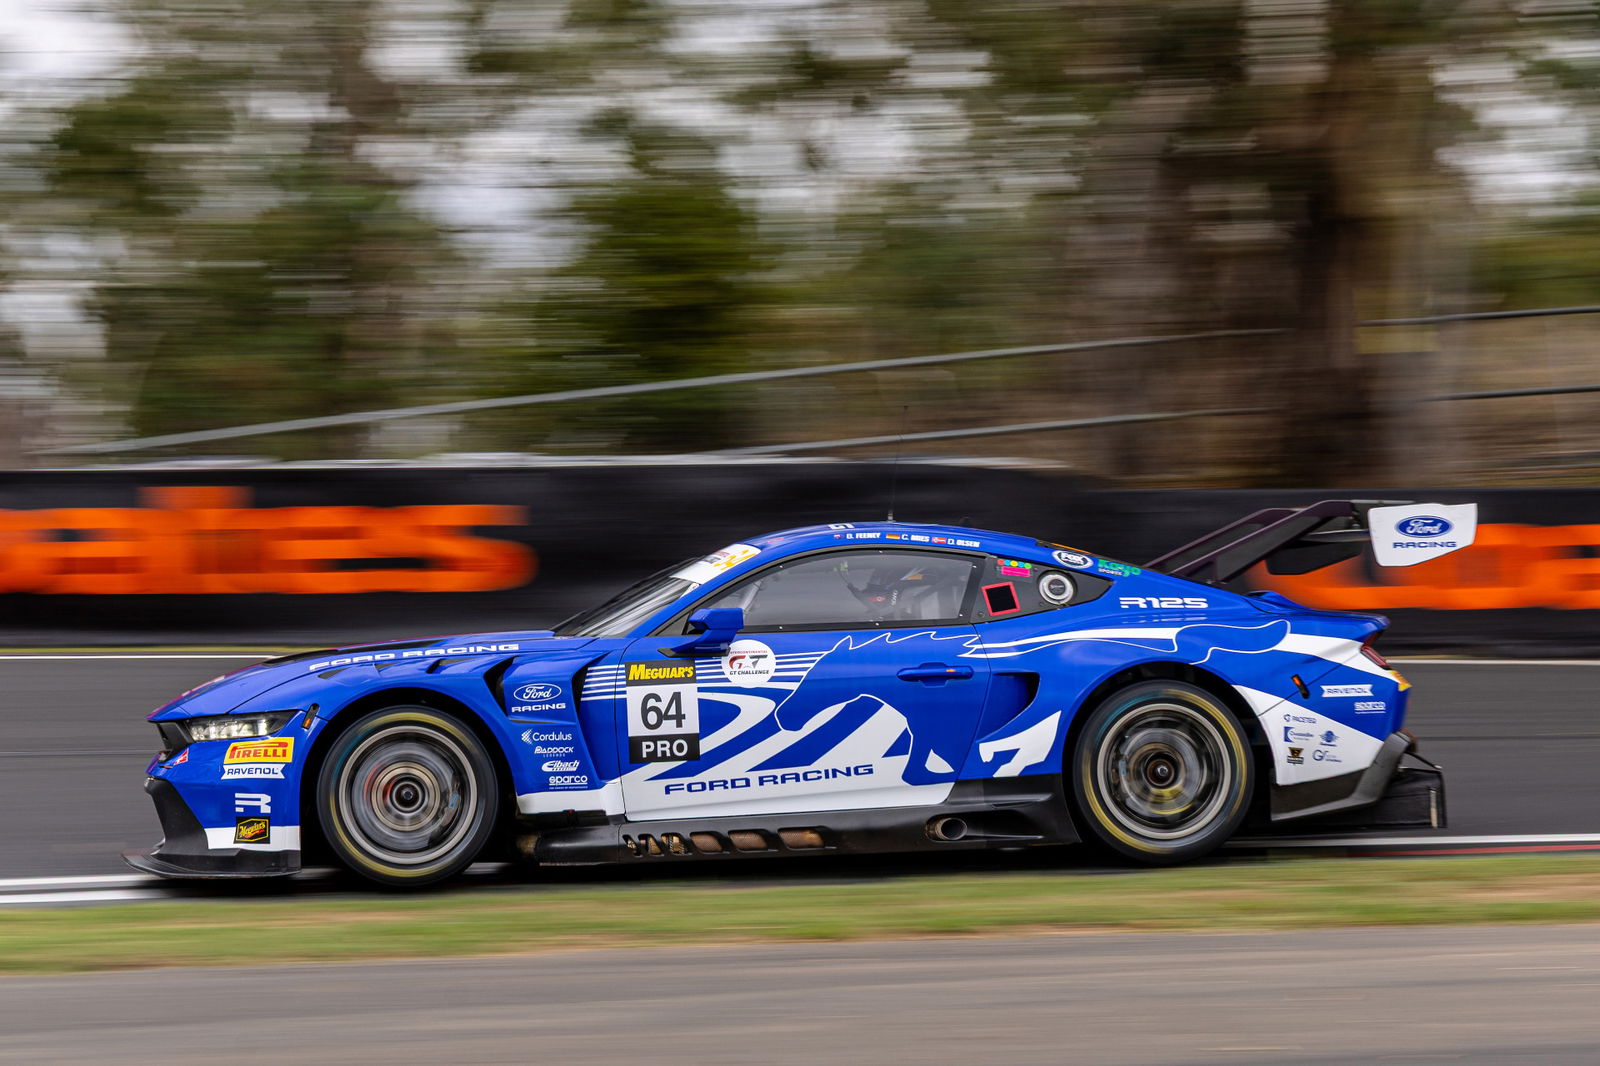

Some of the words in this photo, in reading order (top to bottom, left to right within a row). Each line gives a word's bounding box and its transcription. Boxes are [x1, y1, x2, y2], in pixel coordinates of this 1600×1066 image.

[1405, 518, 1443, 535] Ford
[1393, 541, 1457, 549] RACING
[1119, 597, 1209, 609] R125
[309, 653, 396, 671] FORD
[402, 643, 520, 658] RACING
[522, 685, 553, 699] Ford
[511, 703, 567, 713] RACING
[640, 691, 686, 731] 64
[532, 731, 573, 742] Cordulus
[229, 741, 289, 759] PIRELLI
[534, 746, 574, 754] PADDOCK
[642, 739, 689, 758] PRO
[227, 767, 279, 775] RAVENOL
[549, 775, 588, 786] sparco
[664, 777, 751, 795] FORD
[758, 764, 874, 786] RACING
[235, 792, 271, 814] R
